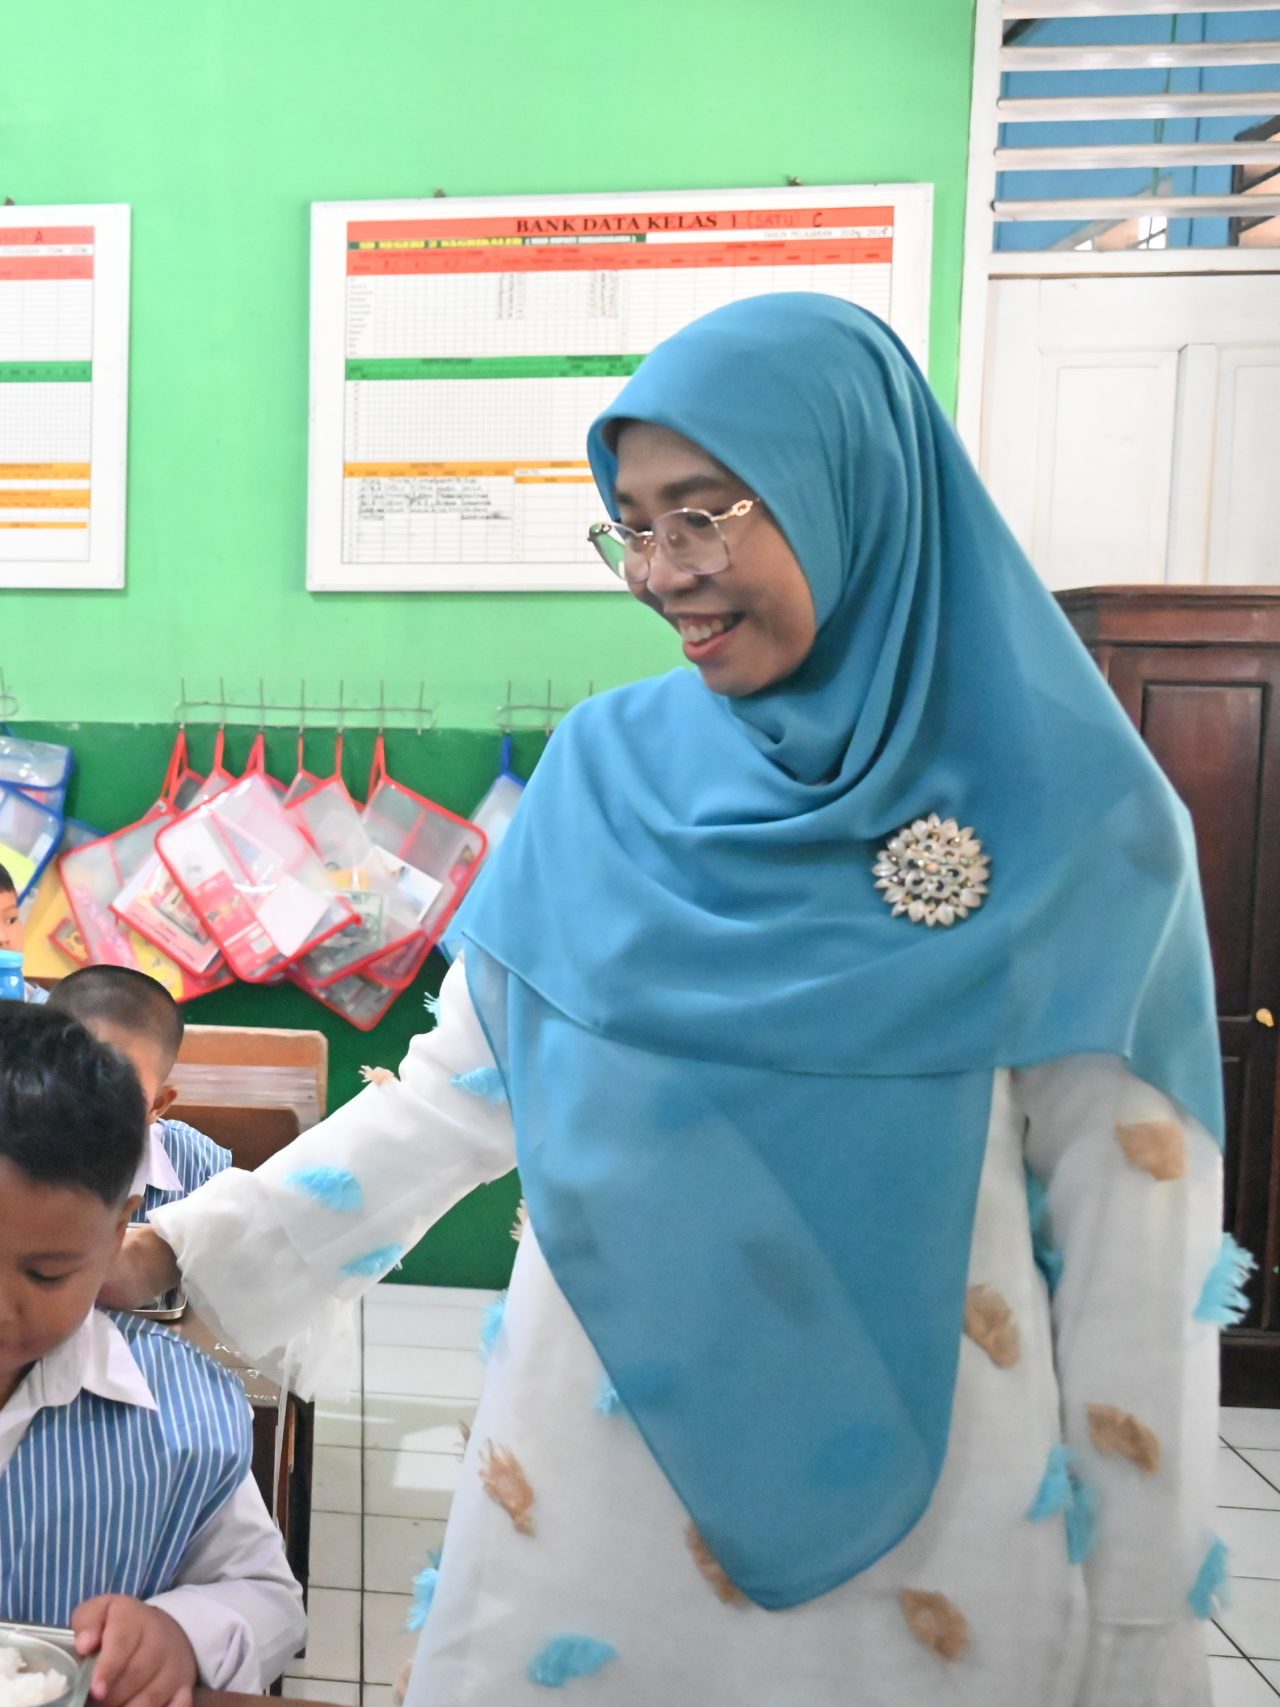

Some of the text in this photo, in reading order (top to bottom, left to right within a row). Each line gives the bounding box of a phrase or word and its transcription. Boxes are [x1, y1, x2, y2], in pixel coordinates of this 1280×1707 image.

[516, 218, 575, 233] BANK
[583, 217, 640, 231] DATA
[647, 215, 718, 230] KELAS
